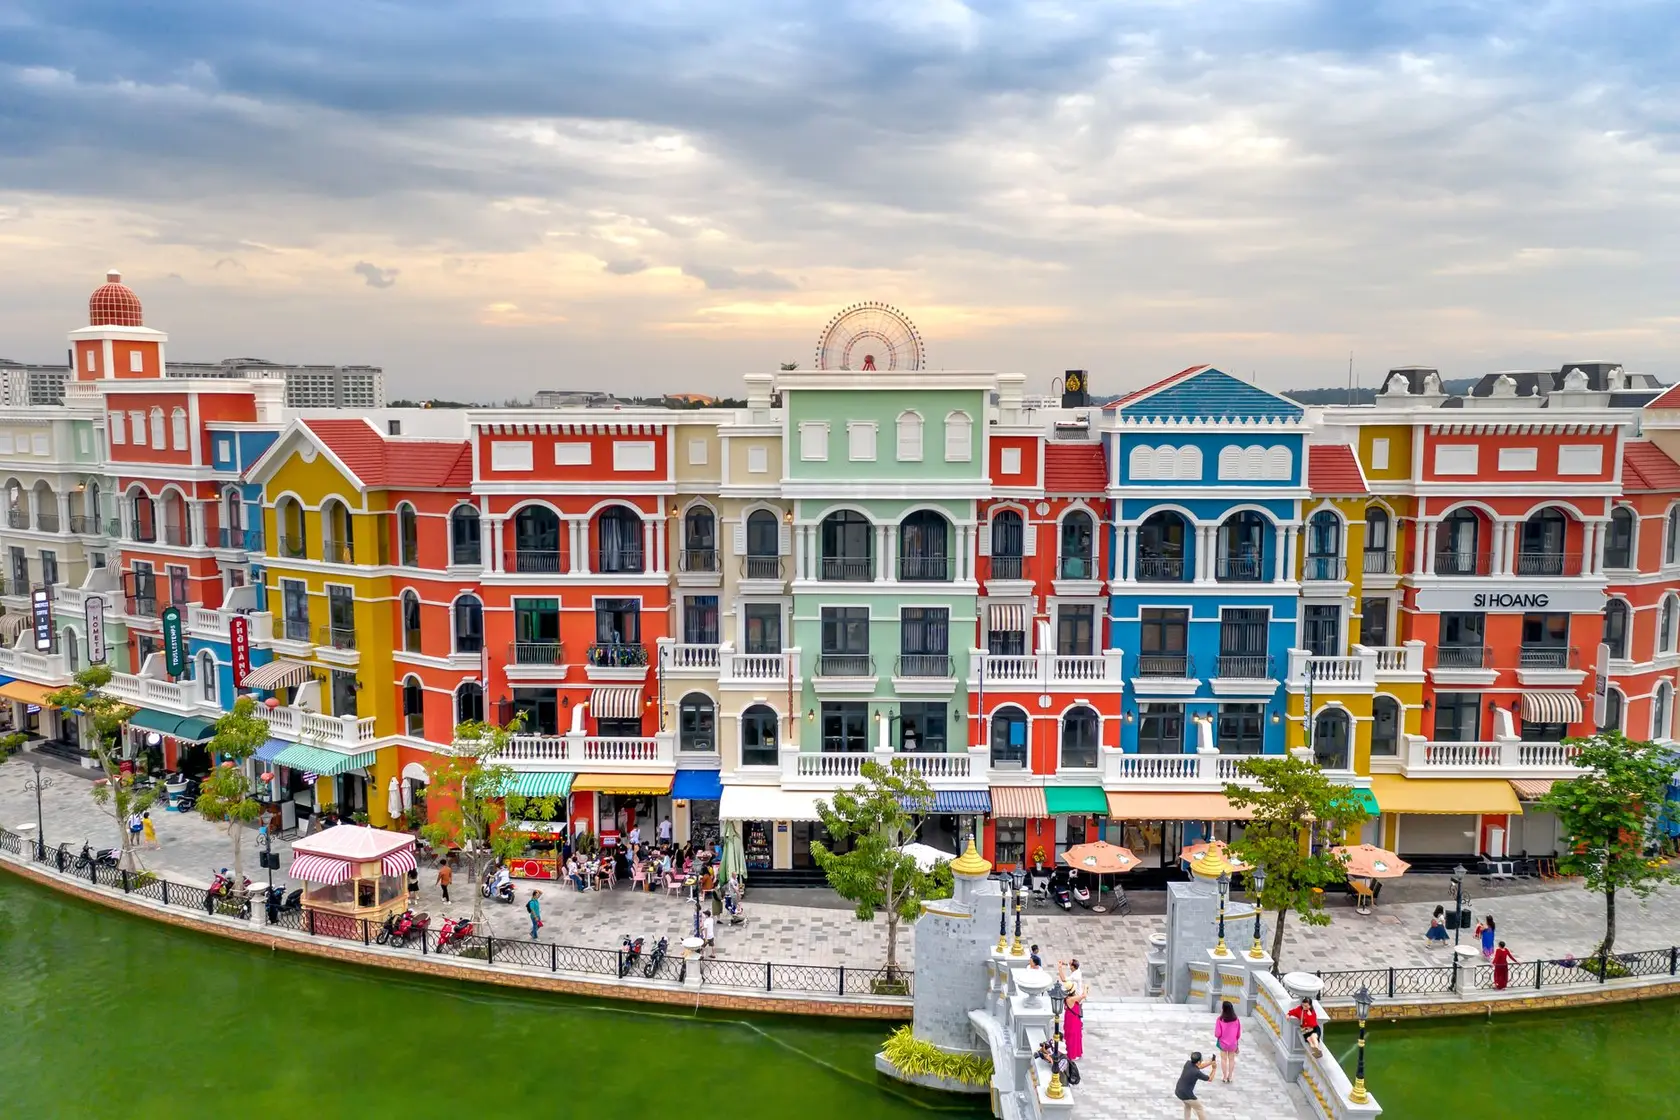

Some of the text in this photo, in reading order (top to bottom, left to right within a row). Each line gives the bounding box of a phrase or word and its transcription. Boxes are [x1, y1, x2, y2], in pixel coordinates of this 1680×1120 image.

[1473, 593, 1549, 607] SI HOANG
[92, 615, 100, 661] HOMETEL
